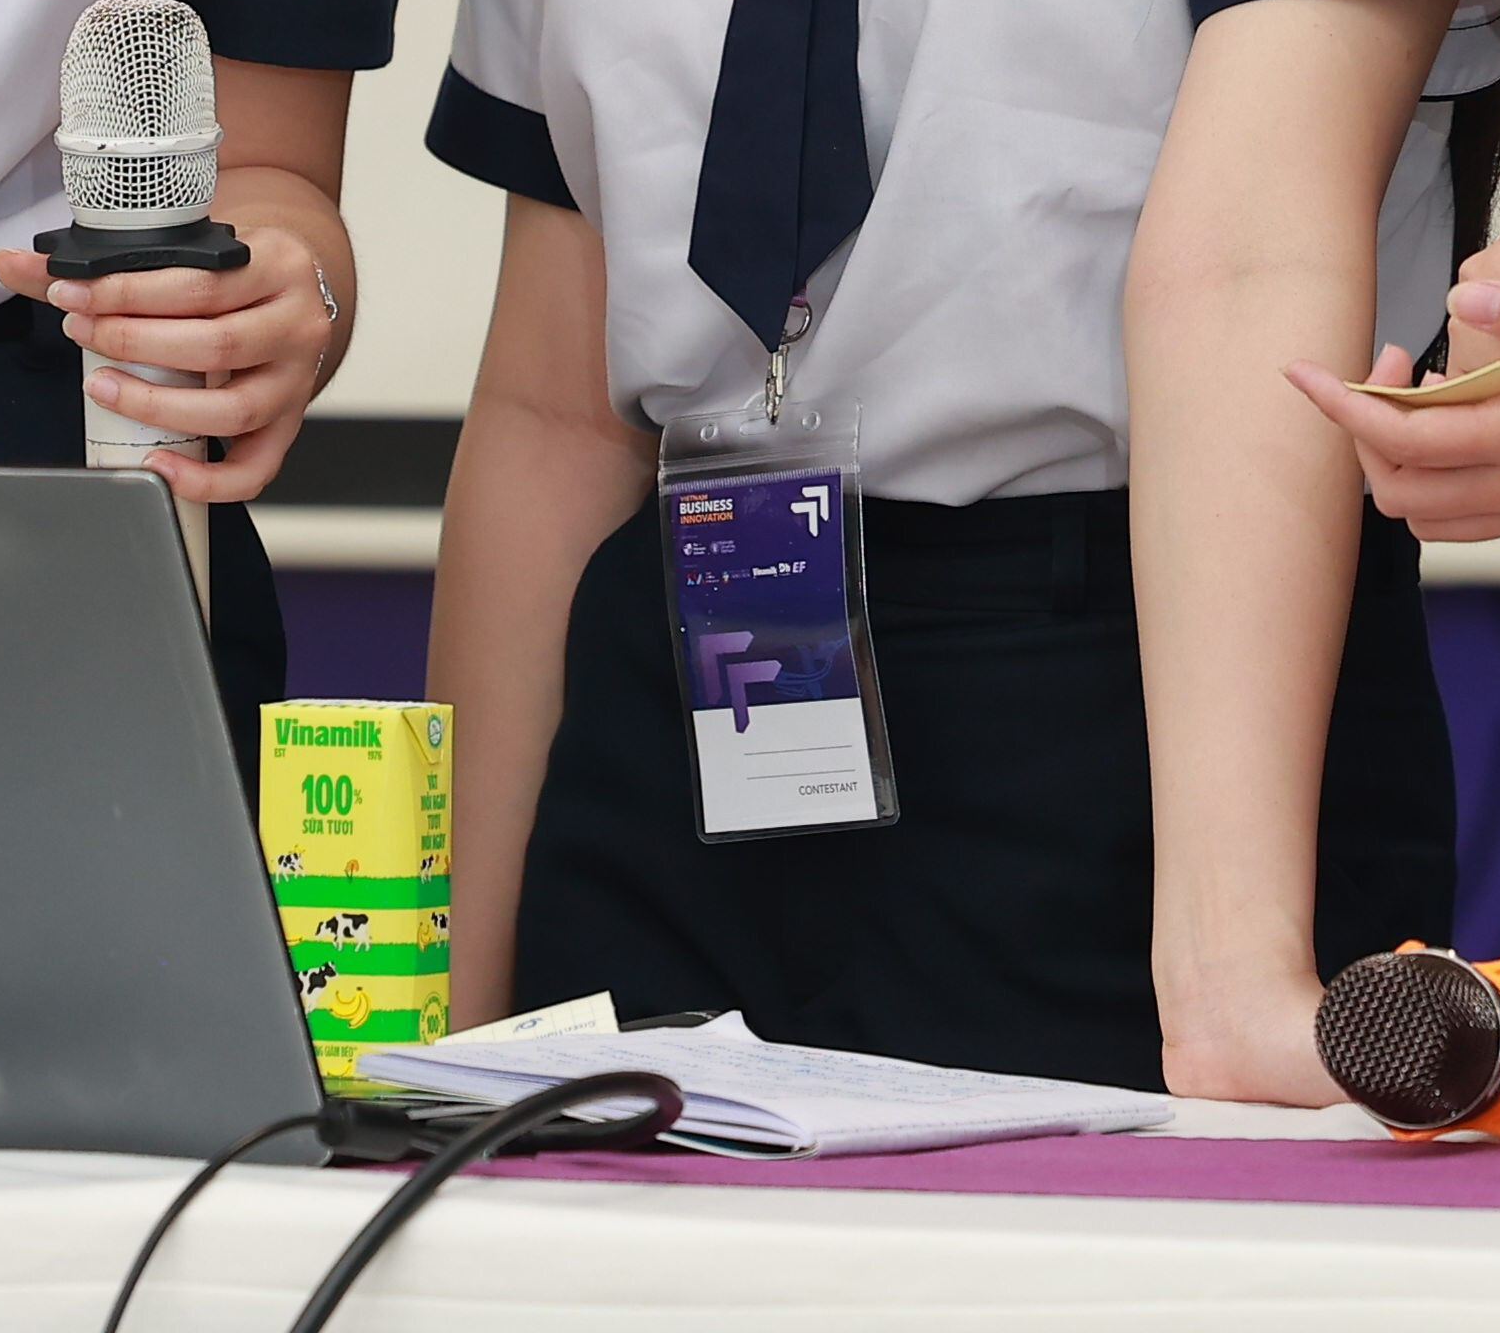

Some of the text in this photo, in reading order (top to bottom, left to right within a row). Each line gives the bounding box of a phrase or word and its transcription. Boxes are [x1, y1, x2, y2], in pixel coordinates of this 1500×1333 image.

[679, 498, 733, 514] BUSINESS
[680, 511, 734, 524] INNOVATION
[792, 561, 806, 573] EF
[275, 718, 382, 748] Vinamilk
[274, 748, 286, 757] EST
[798, 781, 858, 796] CONTESTANT
